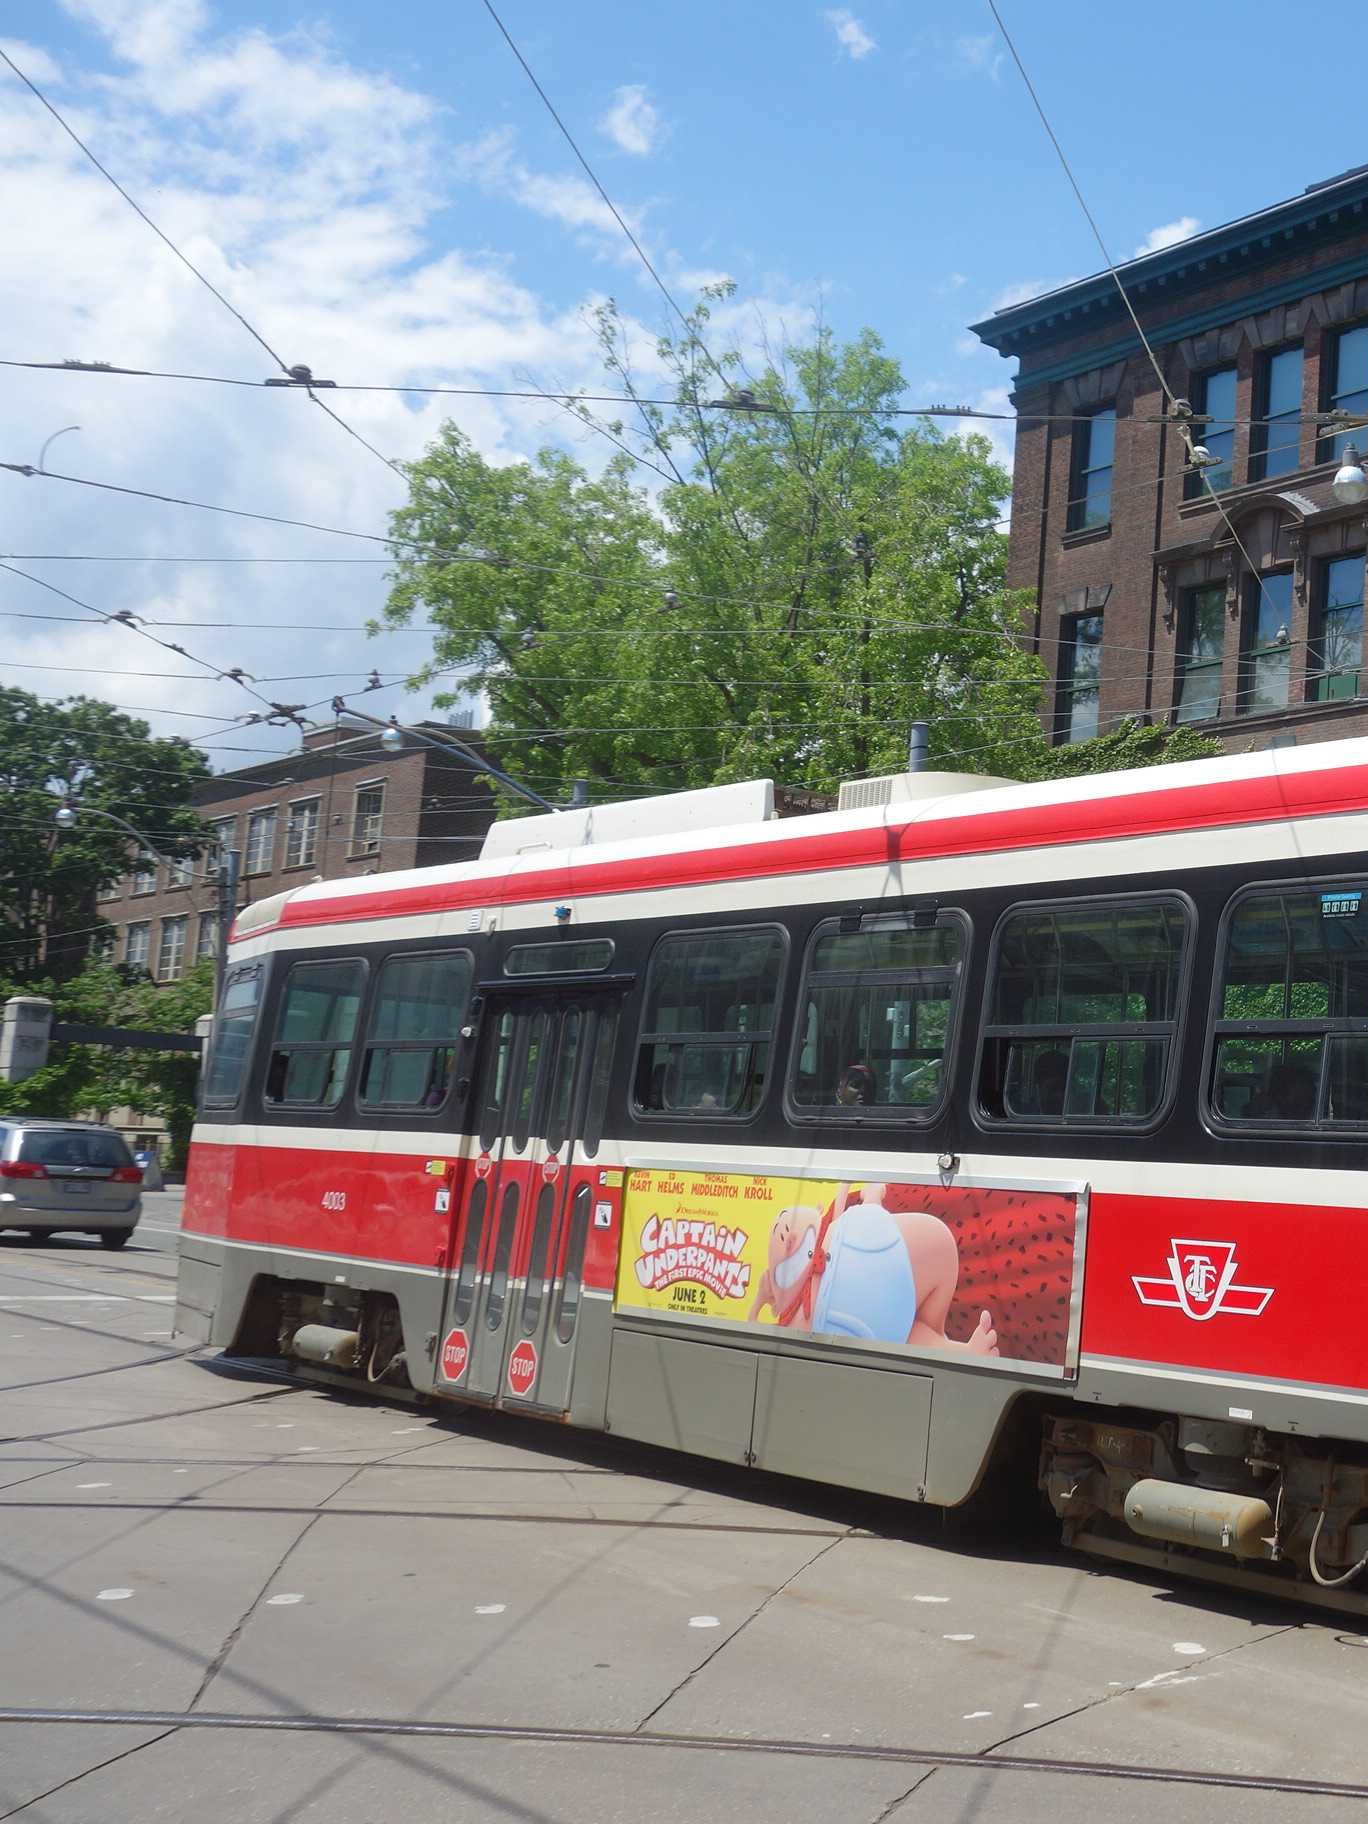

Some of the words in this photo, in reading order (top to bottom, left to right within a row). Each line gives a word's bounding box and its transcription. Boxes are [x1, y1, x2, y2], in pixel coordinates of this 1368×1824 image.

[704, 1174, 728, 1183] THOMAS
[753, 1177, 767, 1185] NICK
[629, 1179, 652, 1192] HART
[657, 1181, 685, 1194] HELMS
[691, 1183, 738, 1198] MIDDLEDITCH
[744, 1186, 773, 1200] KROLL
[321, 1191, 346, 1211] 4003
[635, 1246, 751, 1298] UNDERPANTS
[673, 1287, 697, 1303] JUNE
[699, 1290, 706, 1304] 2
[445, 1345, 466, 1364] STOP
[512, 1357, 534, 1377] STOP
